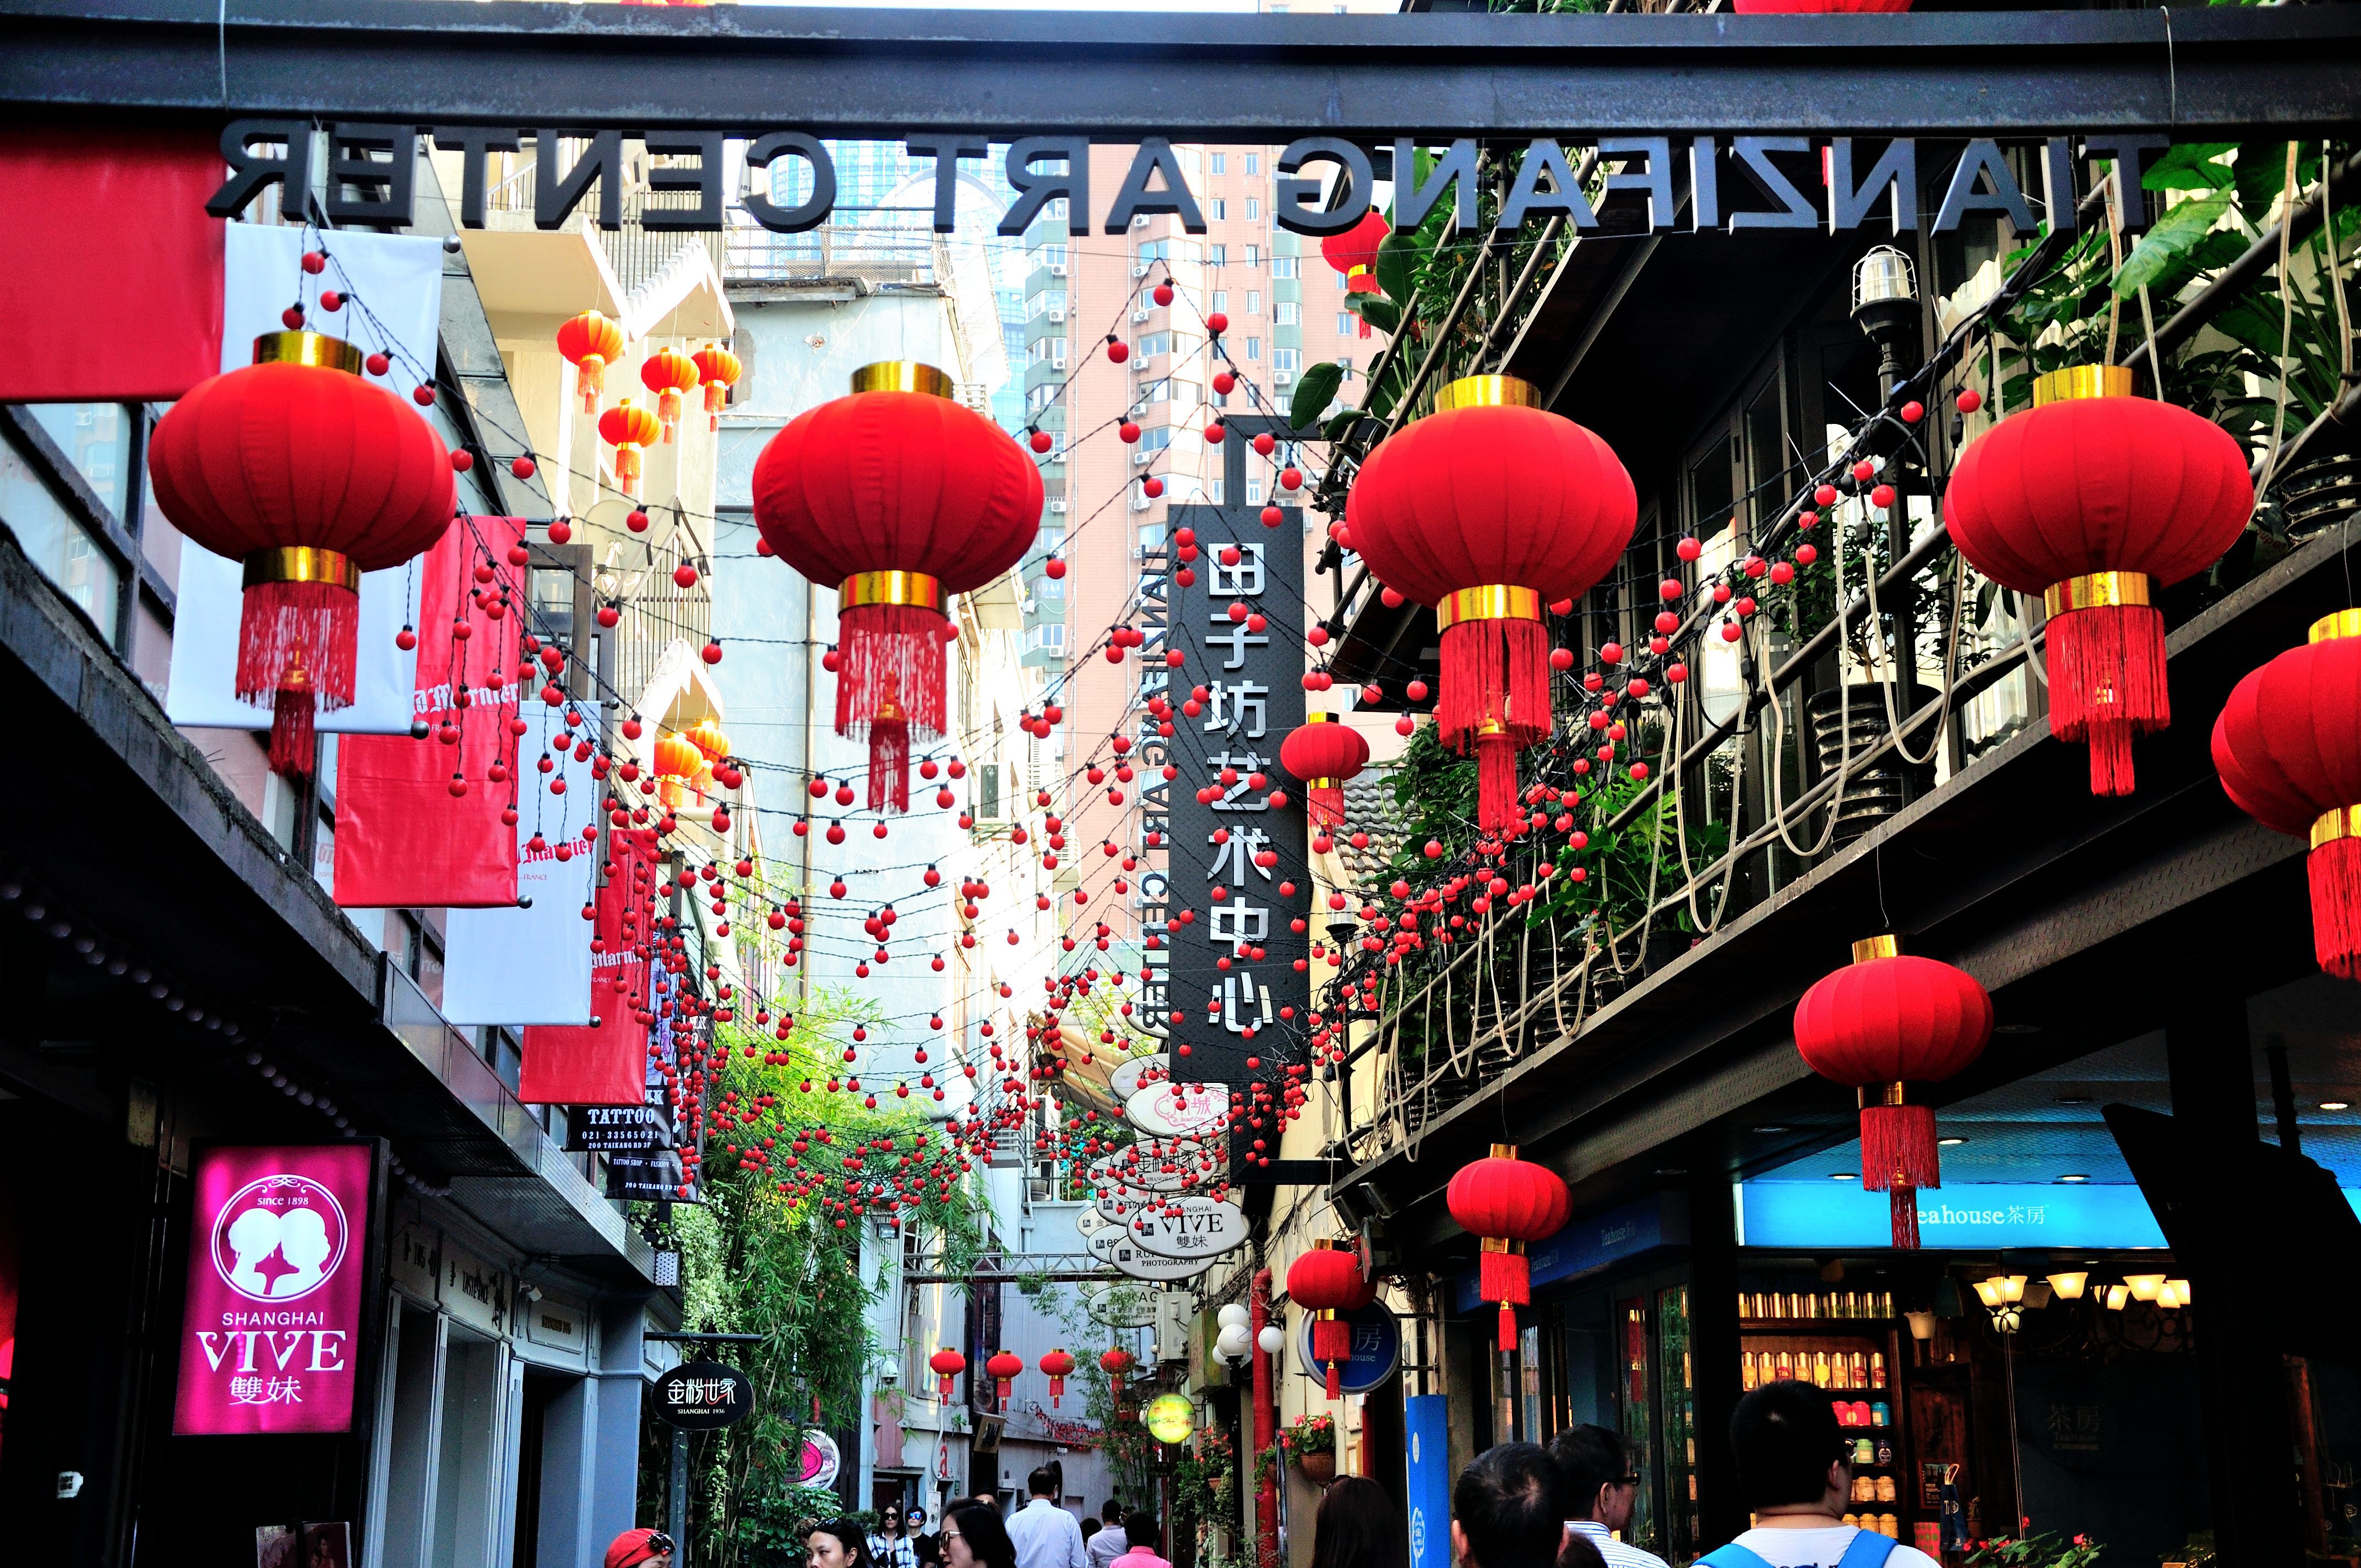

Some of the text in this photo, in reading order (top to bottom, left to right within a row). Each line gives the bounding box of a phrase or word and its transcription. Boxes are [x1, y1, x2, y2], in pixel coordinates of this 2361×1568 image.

[428, 683, 518, 712] Mrnier
[1204, 543, 1273, 1032] 田子坊艺术中心
[587, 1109, 655, 1124] TATTOO
[257, 1196, 309, 1205] since 1898
[1159, 1213, 1223, 1234] VIVE
[1917, 1204, 2005, 1224] eahouse
[2005, 1205, 2046, 1224] 茶房
[222, 1312, 324, 1325] SHANGHAI
[1353, 1323, 1382, 1351] 房
[196, 1330, 346, 1372] VIVE
[229, 1376, 303, 1405] 雙妹
[667, 1378, 736, 1404] 金粉世家
